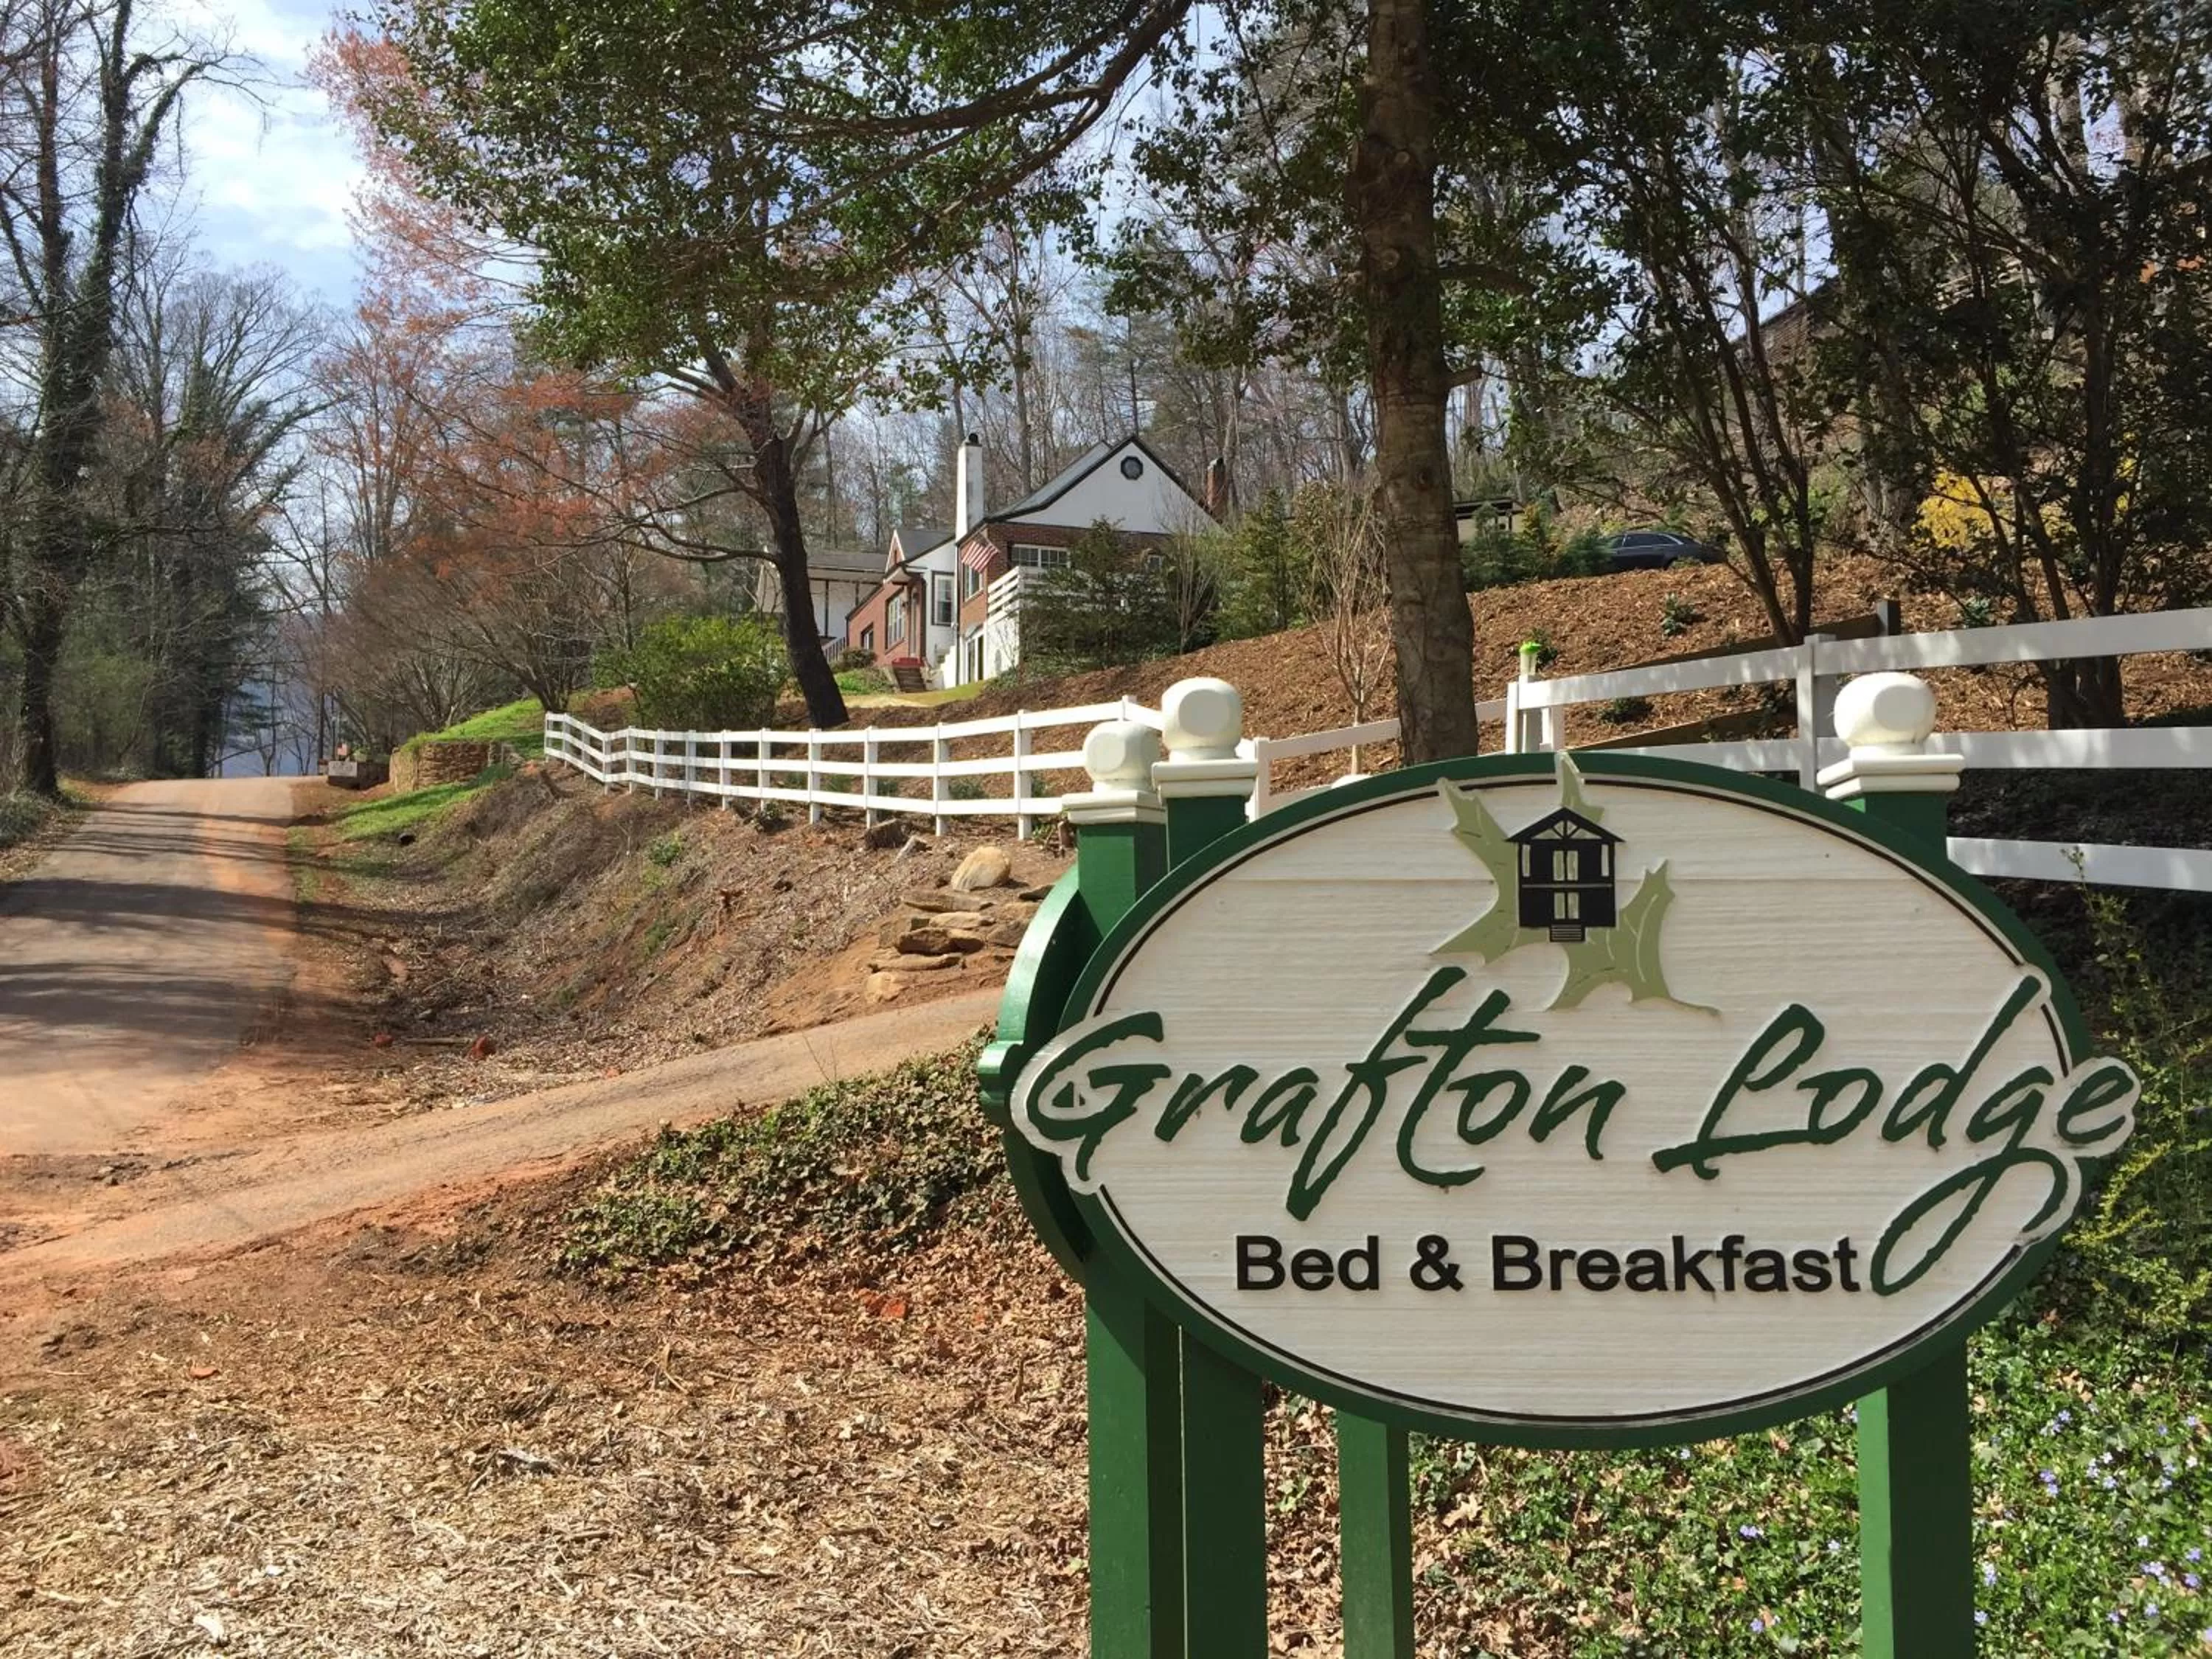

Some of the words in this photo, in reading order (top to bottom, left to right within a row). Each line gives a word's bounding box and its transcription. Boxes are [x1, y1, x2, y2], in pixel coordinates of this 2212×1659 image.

[1026, 966, 1627, 1222] Grafton
[1650, 974, 2135, 1297] Lodge
[1235, 1234, 1380, 1292] Bed
[1408, 1234, 1464, 1293] &
[1492, 1234, 1862, 1293] Breakfast
